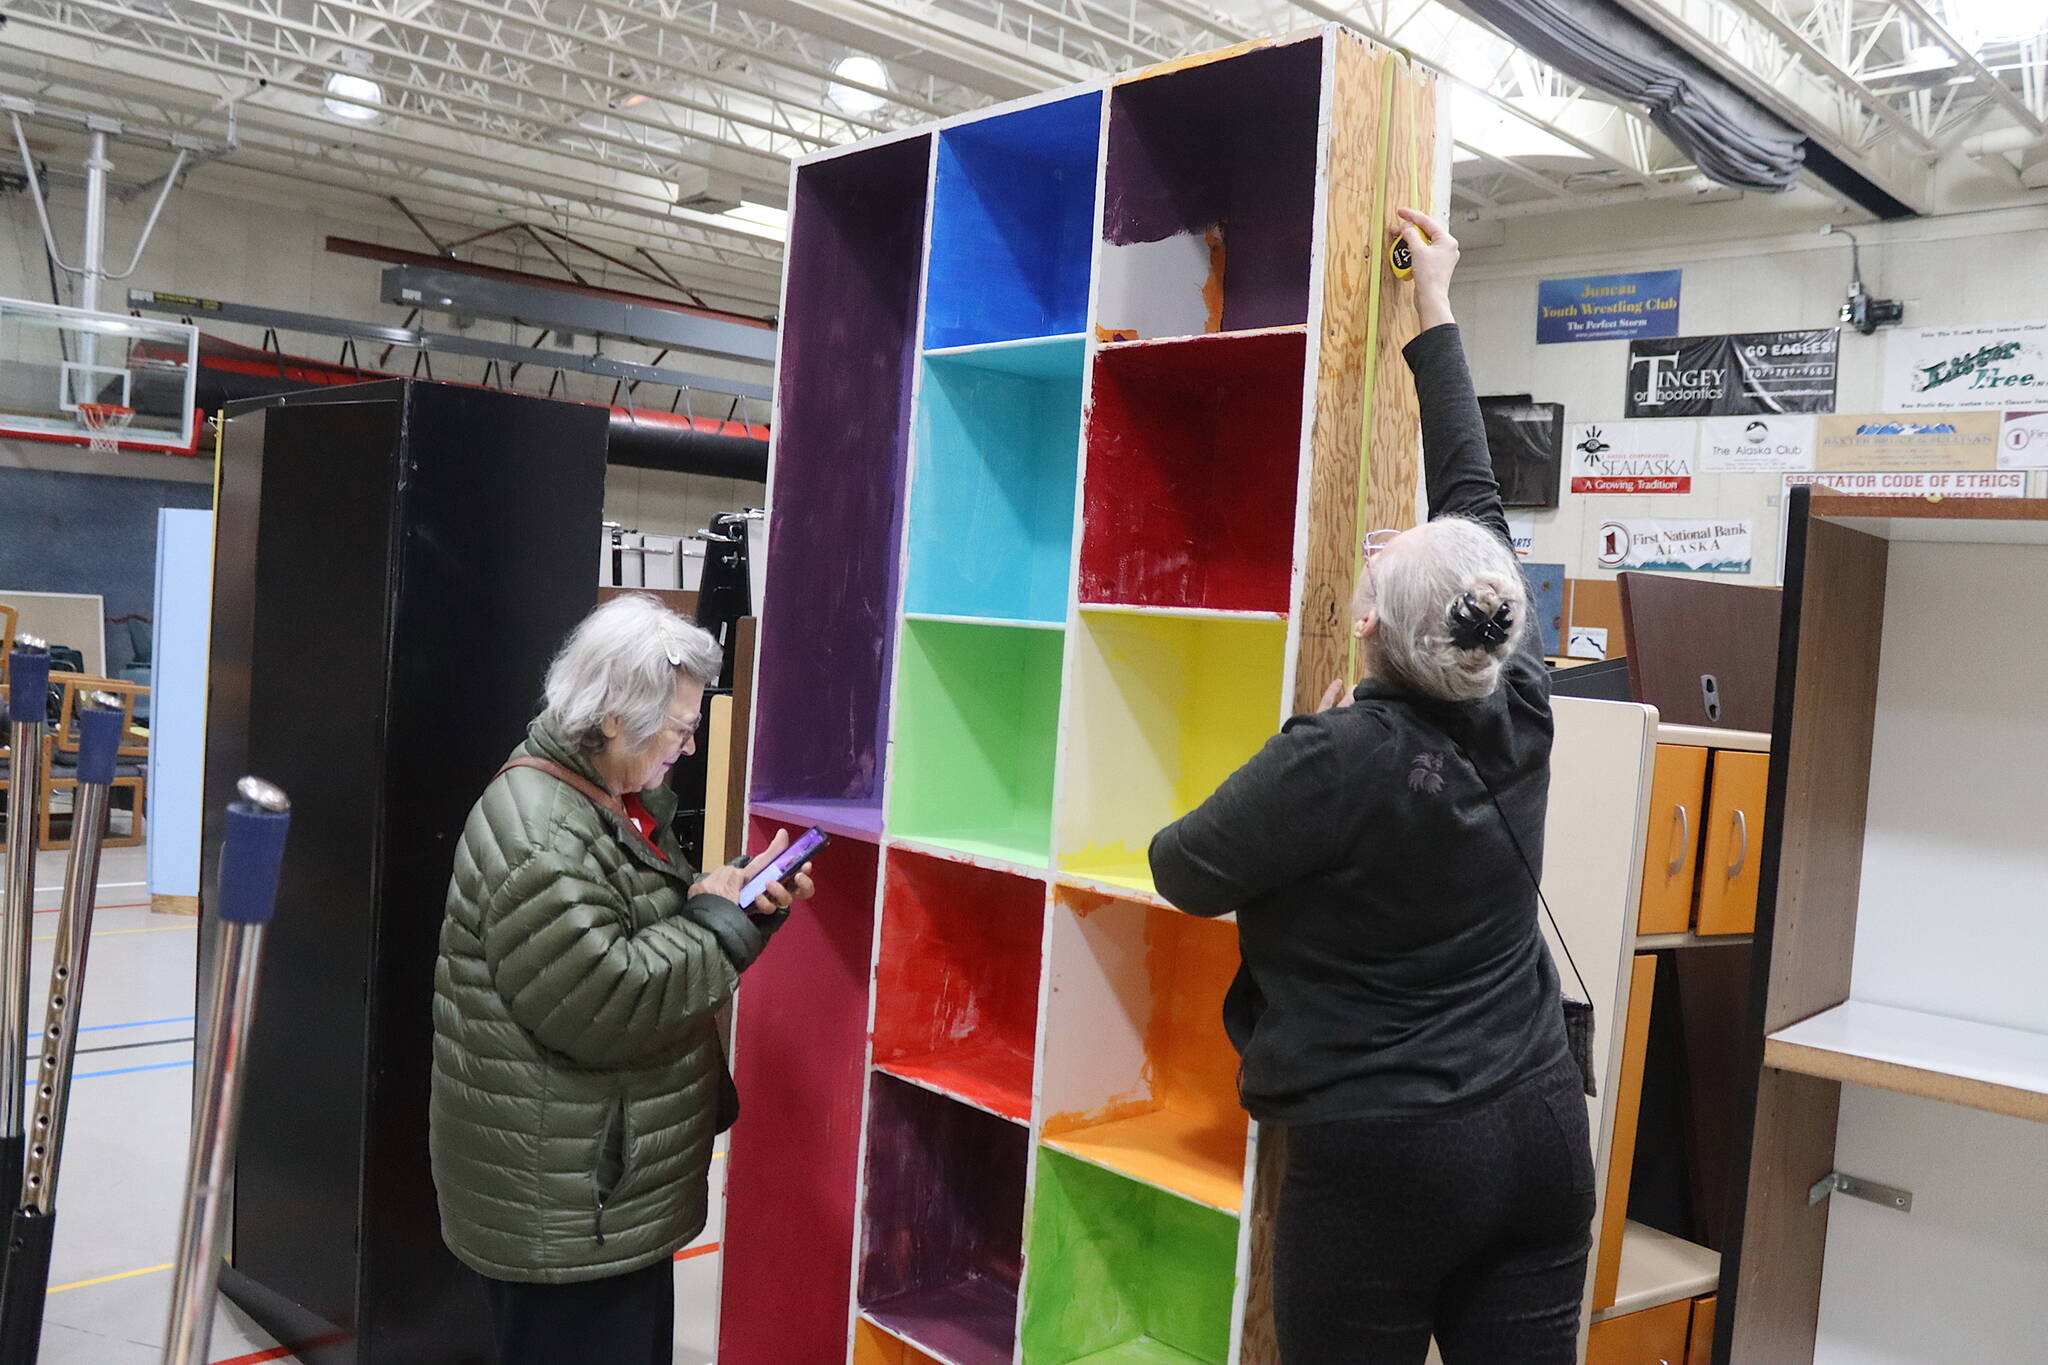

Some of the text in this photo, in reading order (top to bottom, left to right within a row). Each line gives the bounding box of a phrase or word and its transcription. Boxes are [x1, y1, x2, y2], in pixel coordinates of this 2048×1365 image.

[1580, 284, 1637, 298] Juneau
[1542, 297, 1677, 319] Youth Wrestling Club
[1567, 318, 1648, 331] The Perfect Storm
[1745, 344, 1767, 358] GO
[1631, 350, 1726, 406] TINGEY
[1712, 444, 1802, 456] The Alaska Club
[1585, 479, 1678, 492] A Growing Tradition
[1882, 474, 1924, 488] CODE
[1929, 474, 1951, 488] OF
[1956, 473, 2021, 488] ETHICS
[1604, 522, 1747, 556] 1 First National Bank
[1655, 539, 1721, 556] ALASKA
